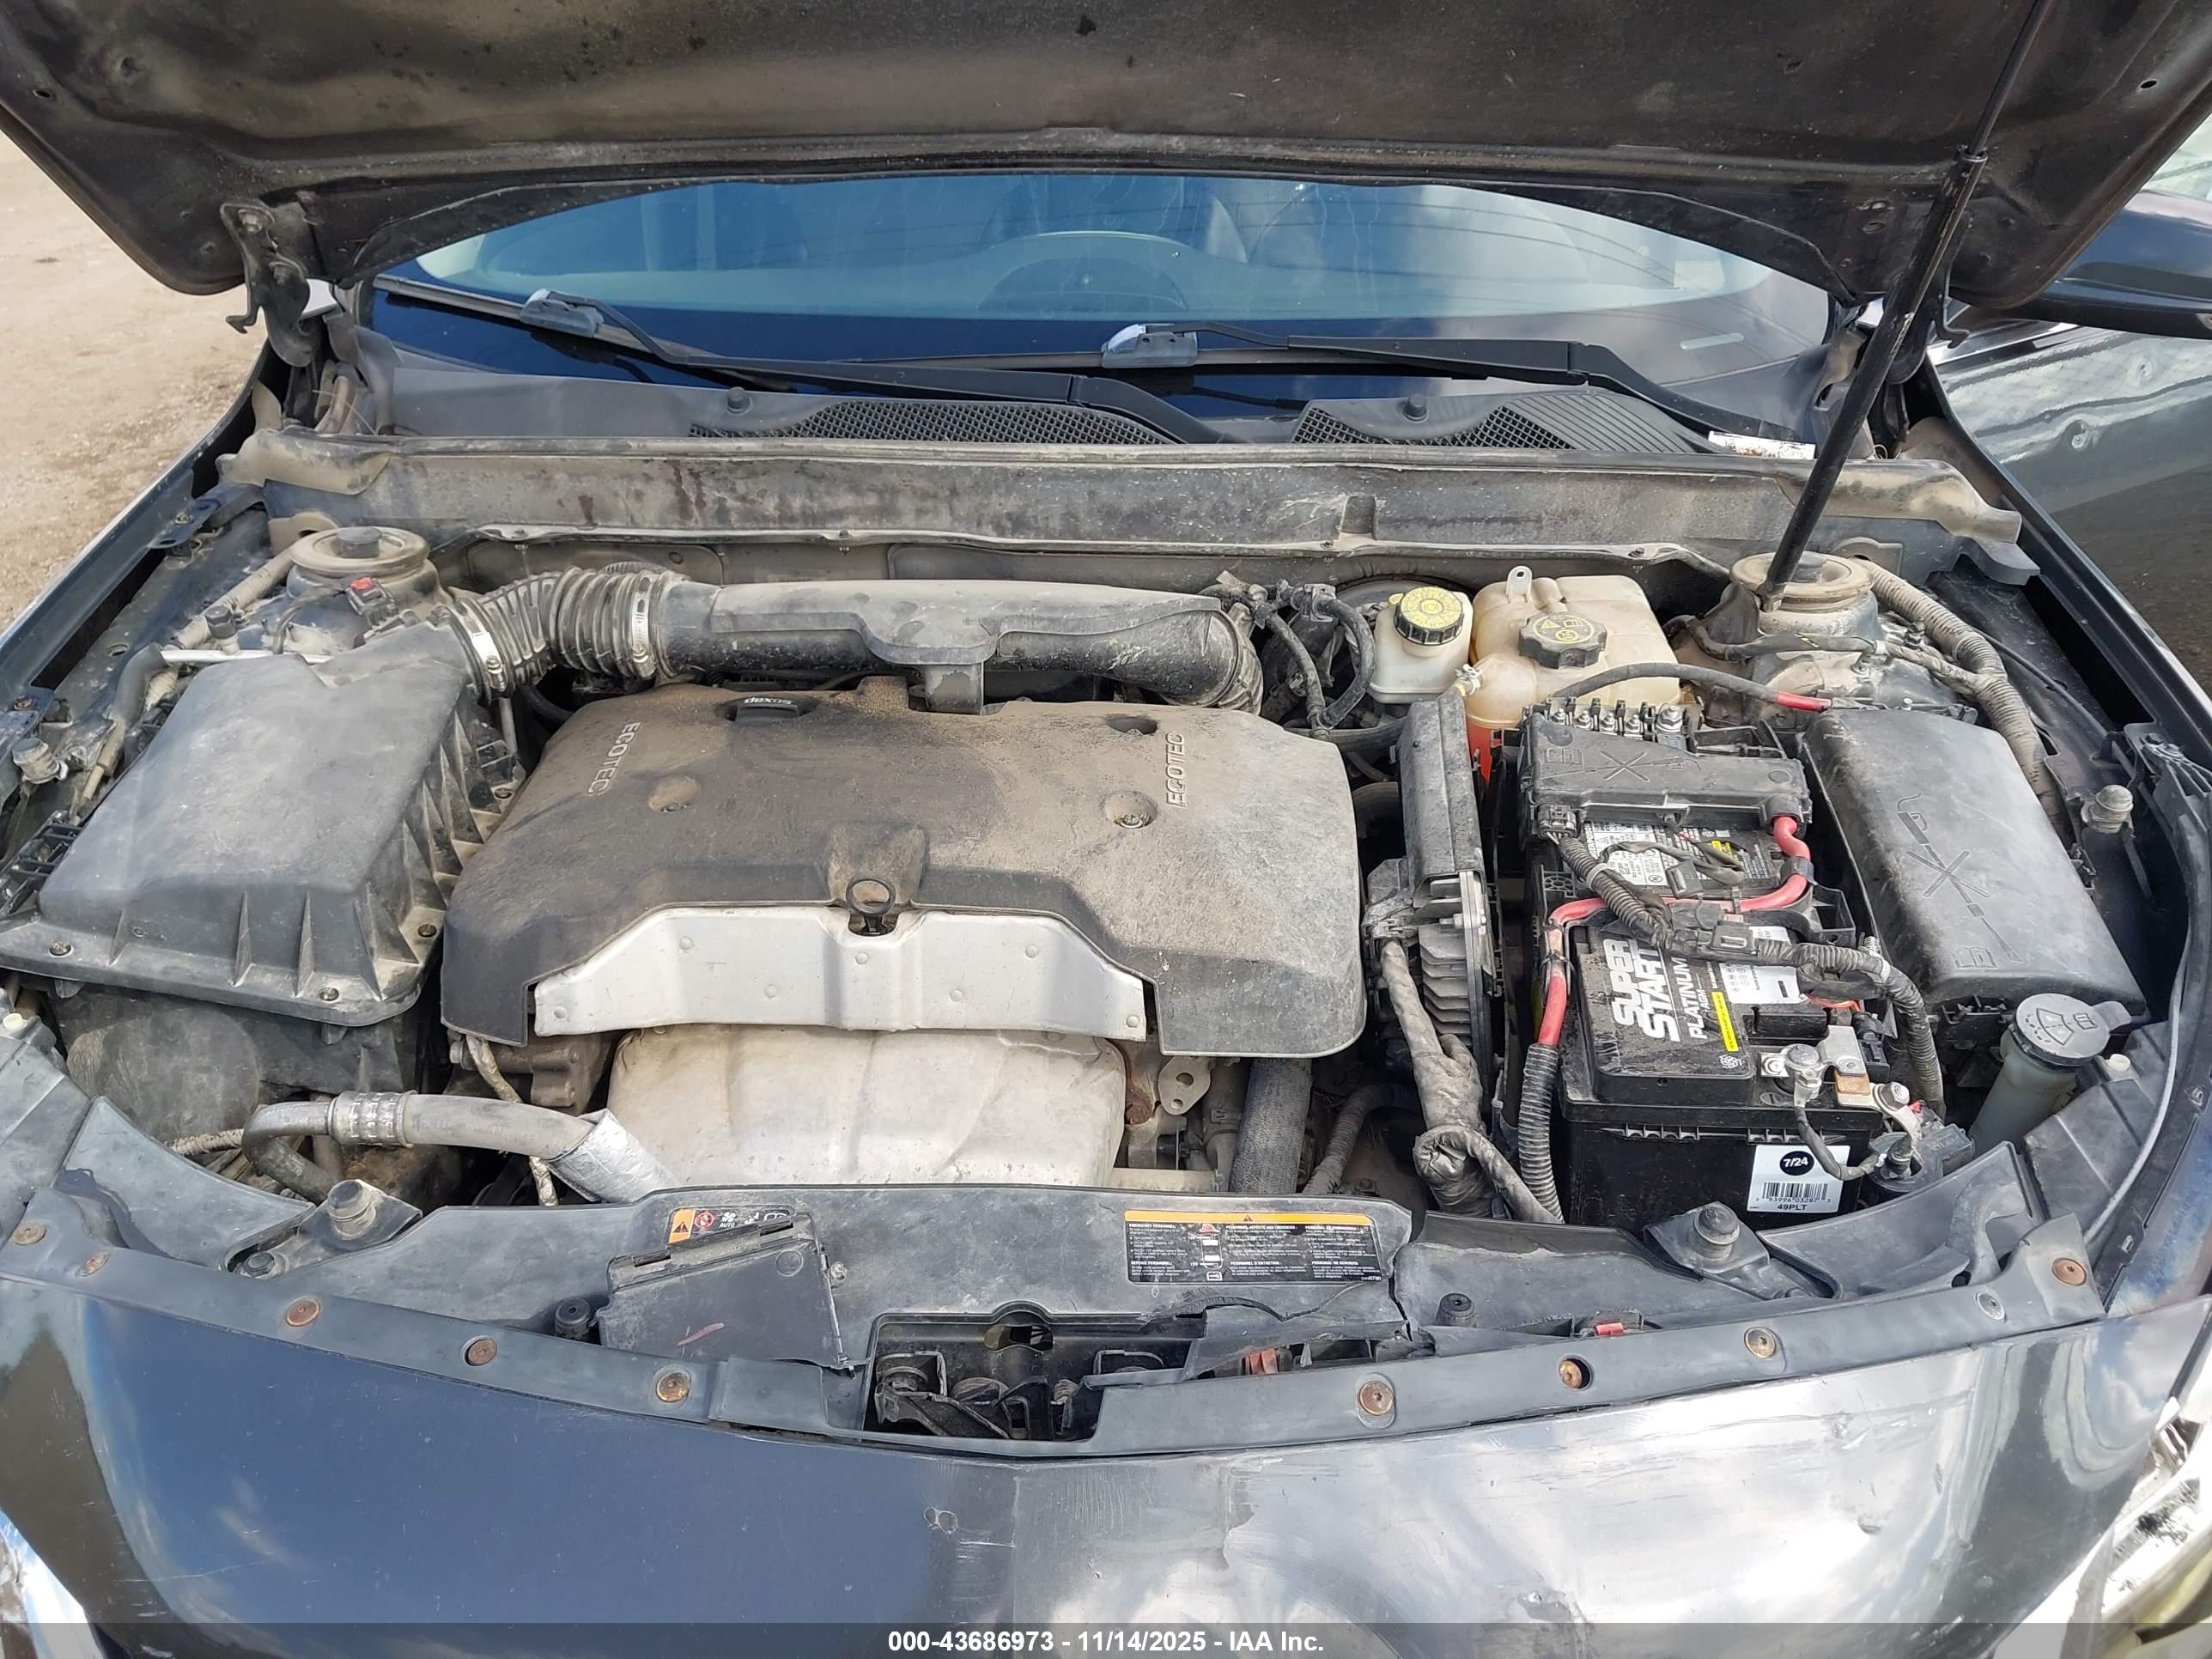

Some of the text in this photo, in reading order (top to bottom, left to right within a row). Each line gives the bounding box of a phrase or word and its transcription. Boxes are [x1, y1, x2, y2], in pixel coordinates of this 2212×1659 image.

[744, 696, 792, 705] dexos
[586, 721, 641, 796] ECOTEC
[1165, 732, 1188, 809] ECOTEC
[1603, 939, 1636, 1027] SUPER
[1628, 938, 1681, 1042] START
[1671, 956, 1709, 1040] PLATINUM
[1783, 1157, 1809, 1168] 7/24
